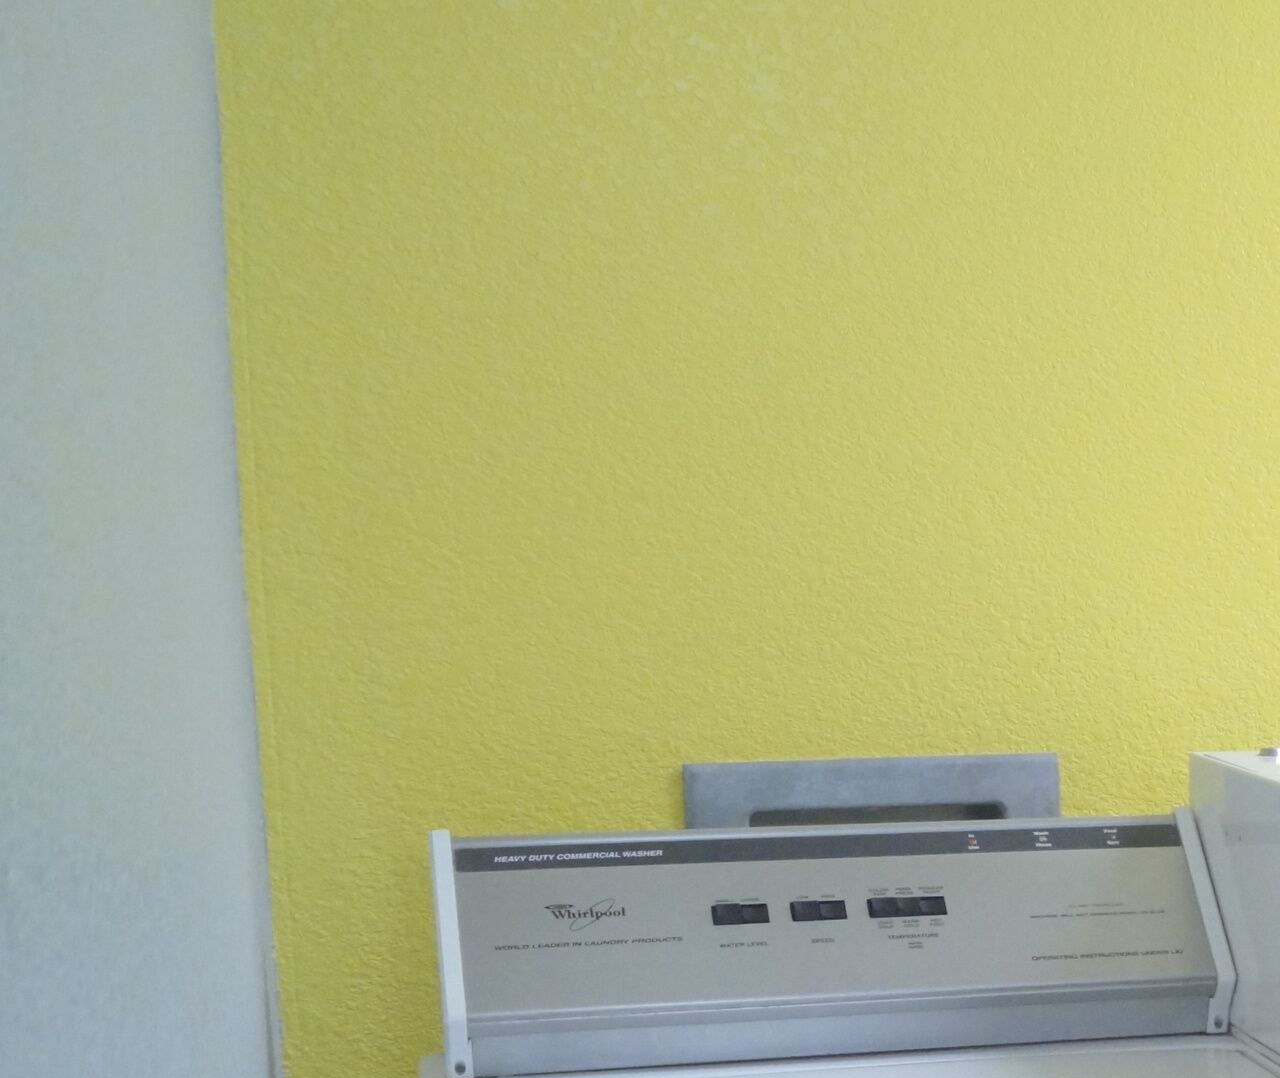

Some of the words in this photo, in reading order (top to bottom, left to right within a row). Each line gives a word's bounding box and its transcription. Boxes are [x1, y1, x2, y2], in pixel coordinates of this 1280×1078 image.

[494, 854, 526, 863] HEAVY
[529, 853, 555, 862] DUTY
[556, 851, 621, 861] COMMERCIAL
[622, 849, 663, 858] WASHER
[551, 906, 627, 921] Whirlpool
[494, 943, 530, 951] WORLD
[532, 942, 570, 950] LEADER
[584, 939, 629, 947] LAUNDRY
[631, 936, 684, 944] PRODUCTS
